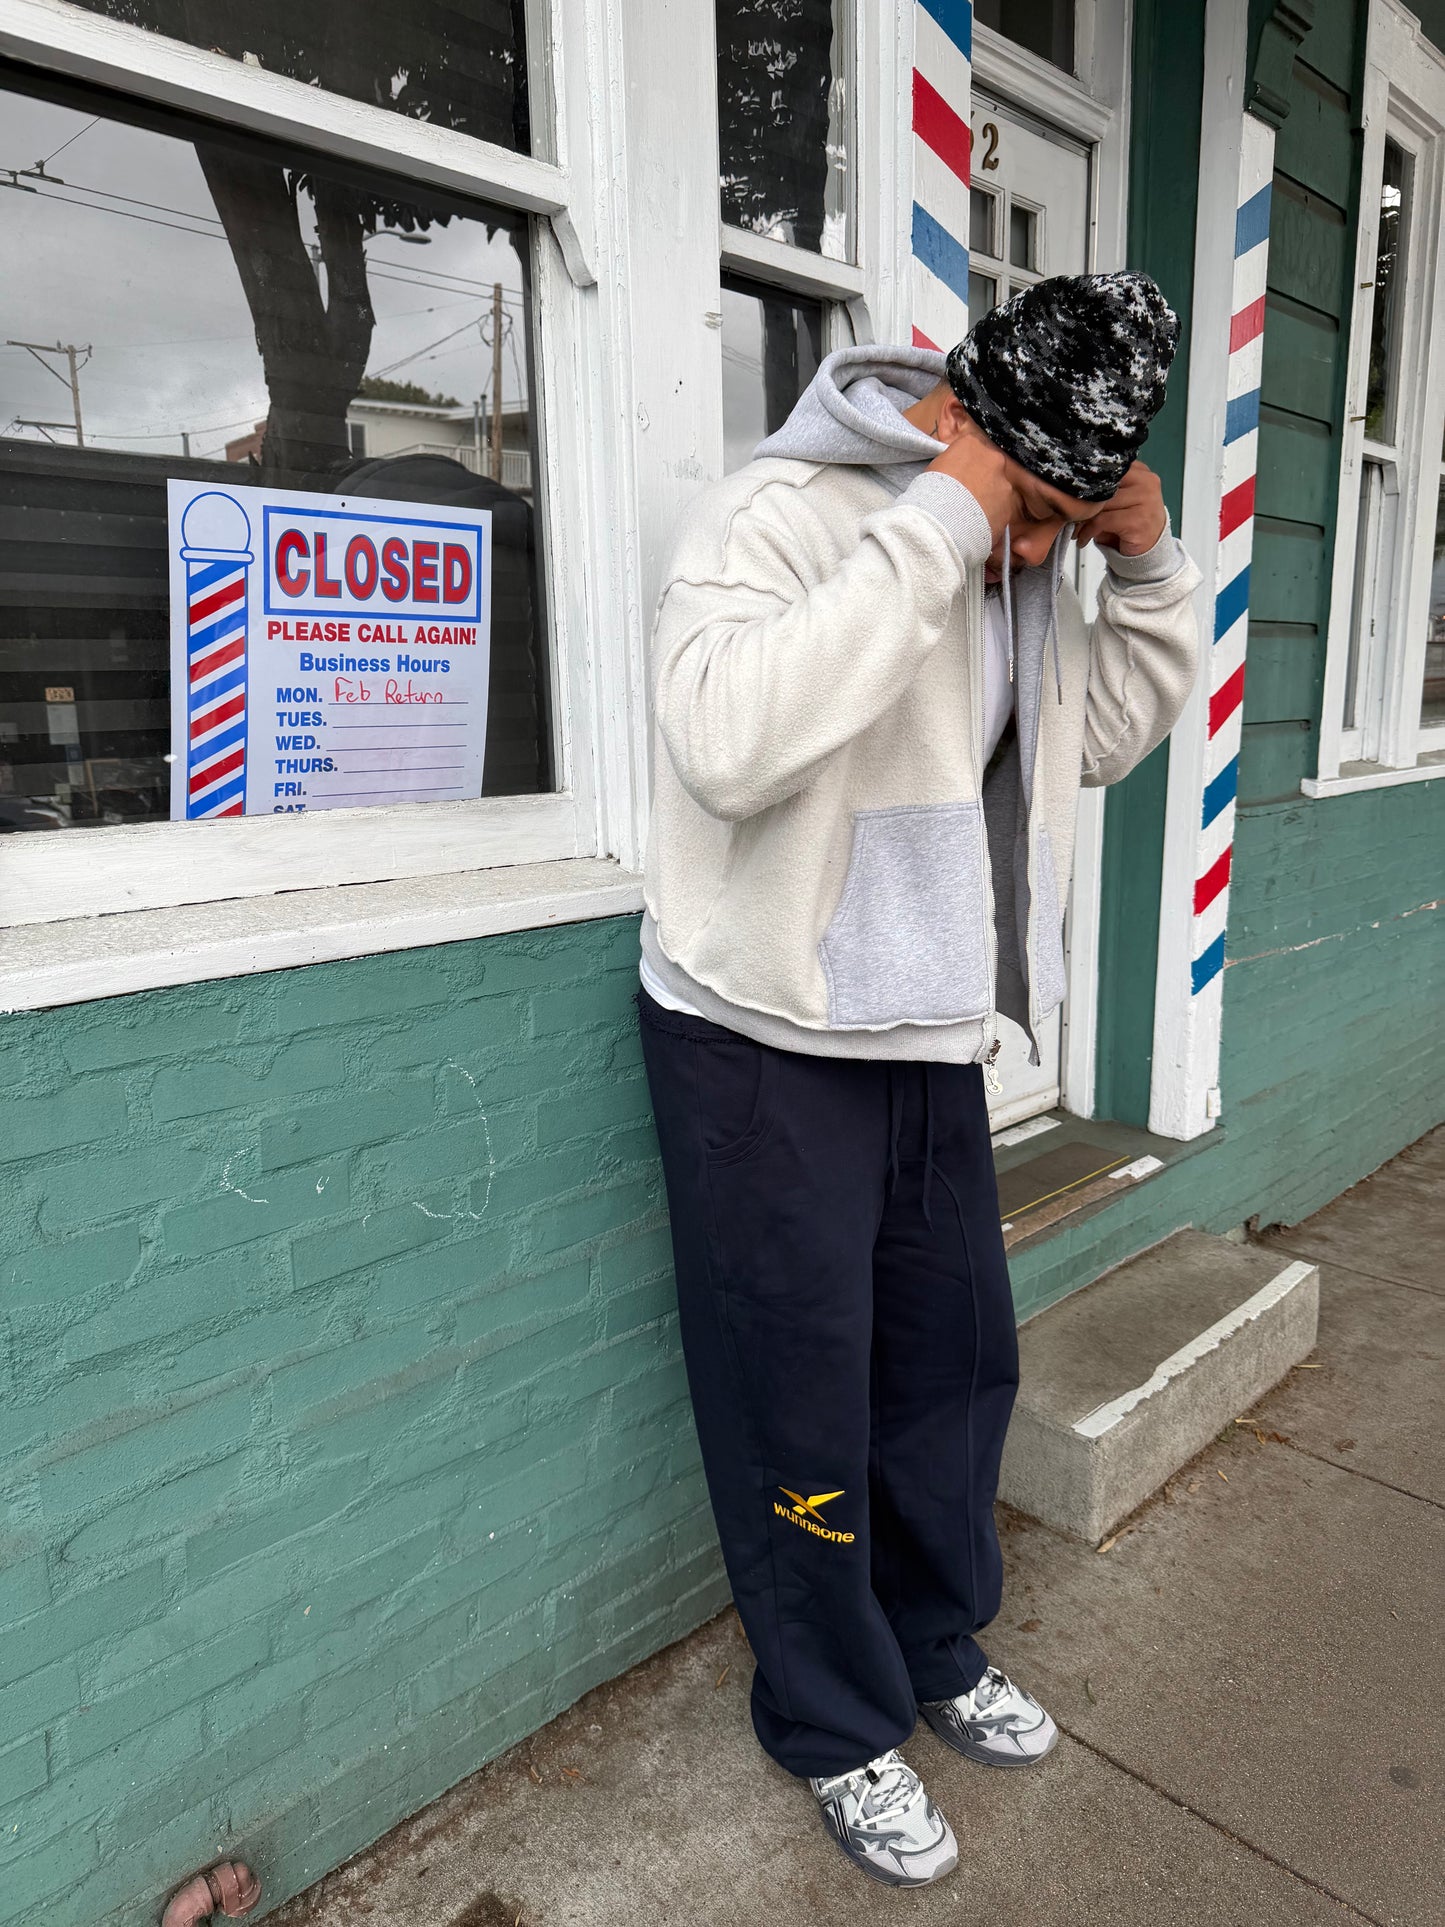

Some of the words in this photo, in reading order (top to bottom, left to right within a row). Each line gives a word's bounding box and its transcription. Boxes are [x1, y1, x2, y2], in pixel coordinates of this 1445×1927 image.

[275, 528, 472, 604] CLOSED
[267, 621, 350, 642] PLEASE
[358, 623, 408, 643] CALL
[414, 626, 477, 645] AGAIN!
[300, 653, 390, 672] Business
[397, 655, 450, 673] Hours
[276, 687, 323, 703] MON.
[334, 676, 371, 703] Feb
[385, 679, 443, 704] Return
[276, 711, 327, 727] TUES.
[275, 735, 320, 750] WED.
[275, 757, 338, 774] THURS.
[274, 781, 307, 797] FRI.
[773, 1502, 855, 1543] wunnaone
